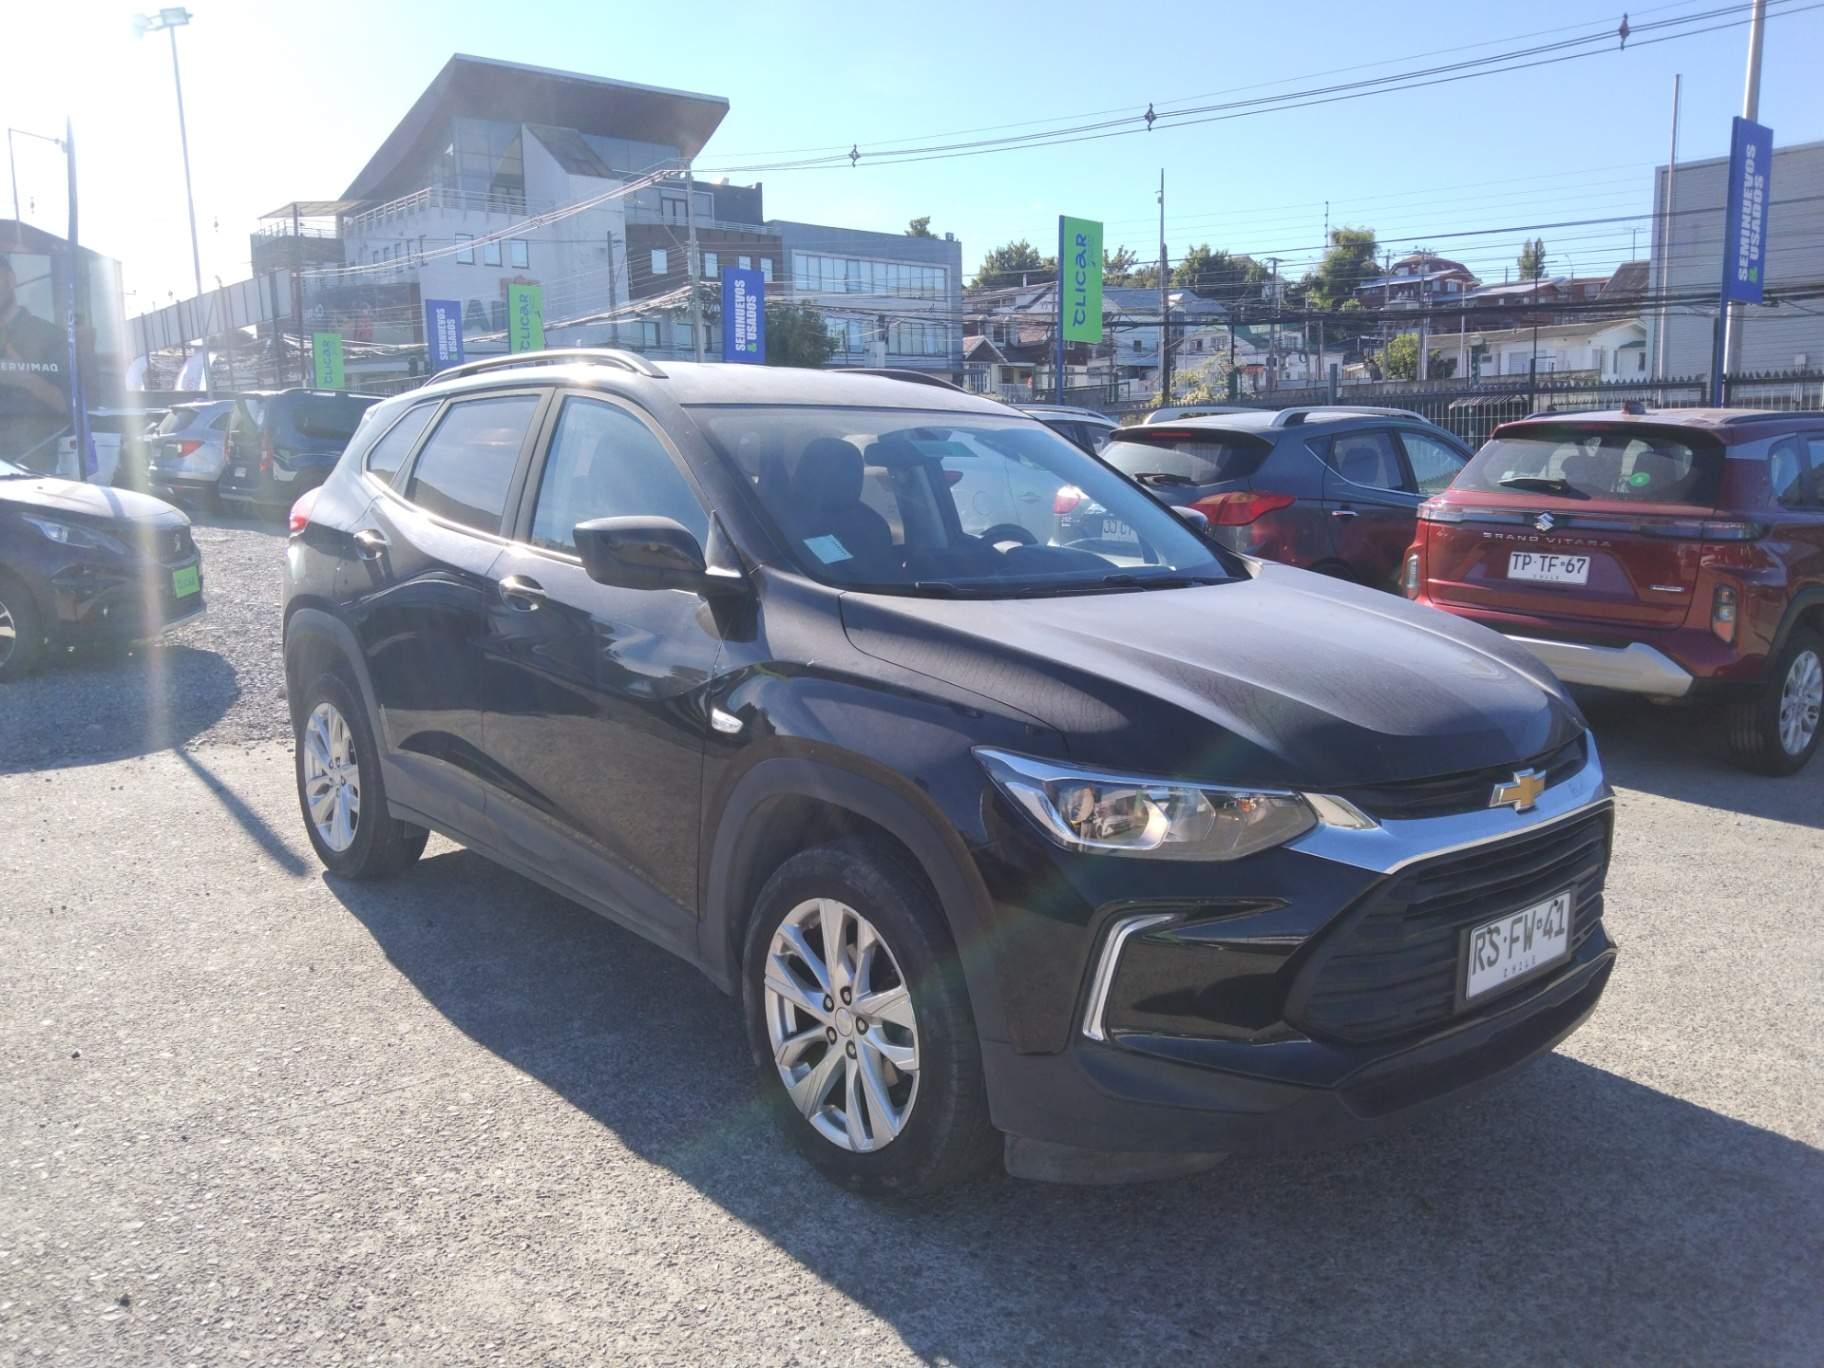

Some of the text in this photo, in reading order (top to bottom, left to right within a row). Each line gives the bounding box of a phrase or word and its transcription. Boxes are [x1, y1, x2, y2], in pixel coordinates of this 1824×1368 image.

[1738, 144, 1757, 282] SEMINUEVOS
[1750, 175, 1764, 261] USADOS
[734, 279, 746, 352] SEMINUEVOS
[746, 295, 757, 341] USADOS
[0, 361, 59, 372] ERVIMAQ
[1546, 536, 1612, 547] VITARA
